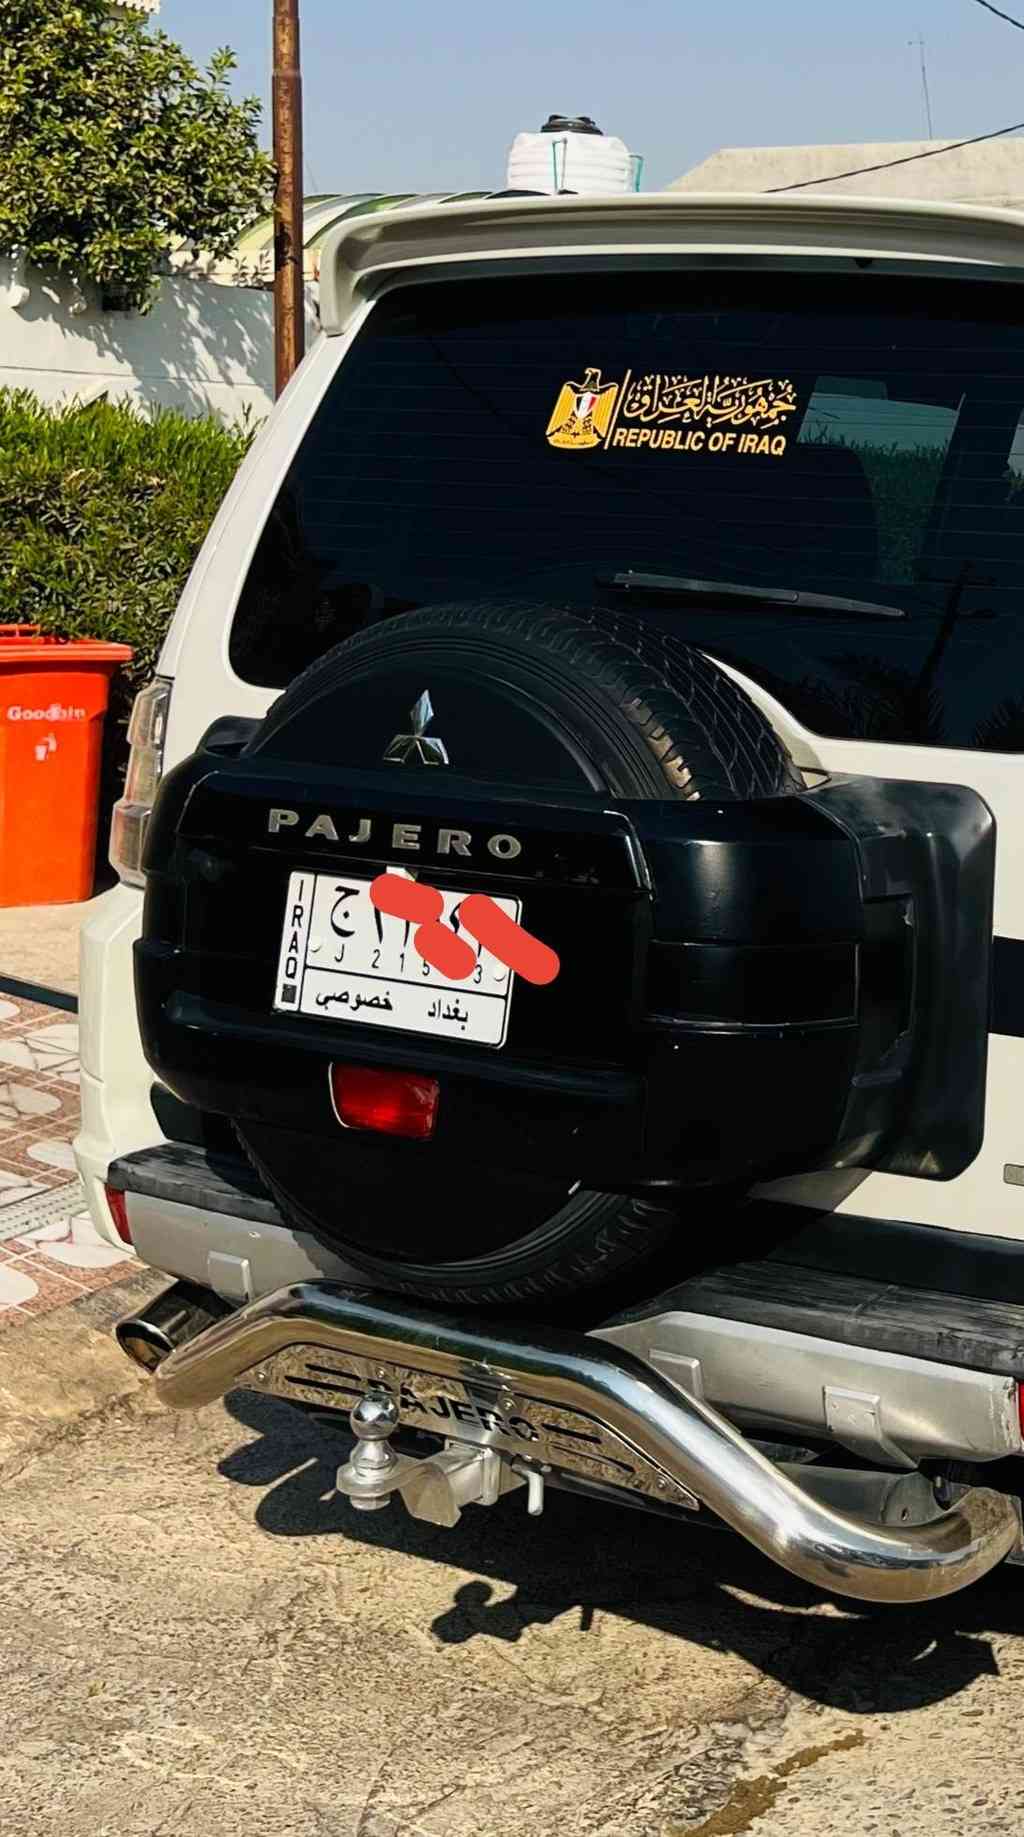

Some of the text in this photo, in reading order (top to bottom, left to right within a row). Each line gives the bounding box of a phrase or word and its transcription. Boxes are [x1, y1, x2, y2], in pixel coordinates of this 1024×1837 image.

[612, 428, 787, 456] REPUBLIC OF IRAQ
[267, 807, 522, 860] PAJERO
[285, 879, 305, 979] IRAQ
[315, 989, 469, 1031] بغداد خصوصي
